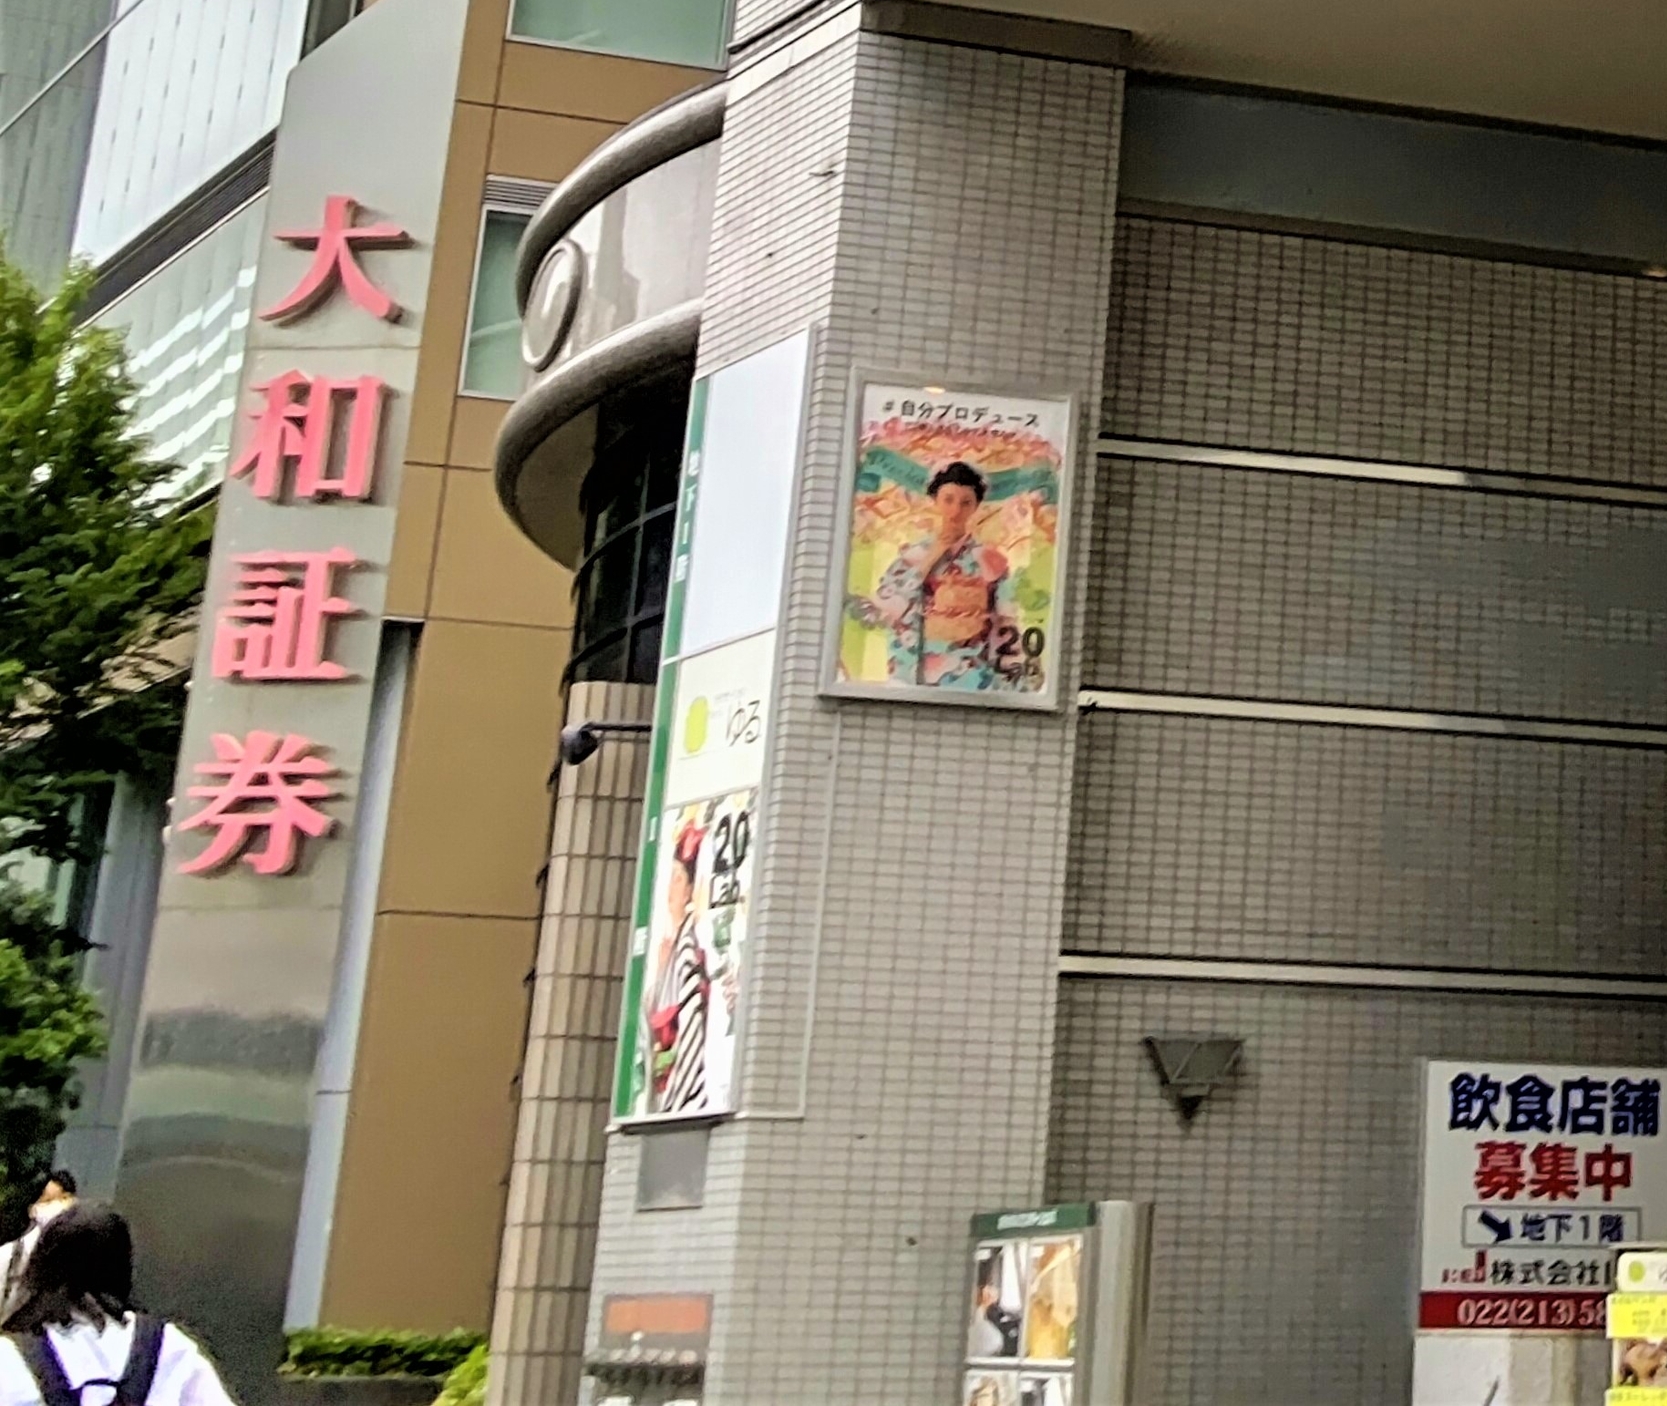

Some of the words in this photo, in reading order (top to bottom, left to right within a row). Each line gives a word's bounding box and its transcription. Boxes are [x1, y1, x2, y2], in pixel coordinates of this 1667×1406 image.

[177, 194, 412, 875] 大和証券
[996, 625, 1045, 657] 20
[713, 810, 749, 875] 20
[1449, 1072, 1661, 1137] 飲食店舗
[1473, 1141, 1633, 1202] 募集中
[1520, 1213, 1624, 1243] 地下1階
